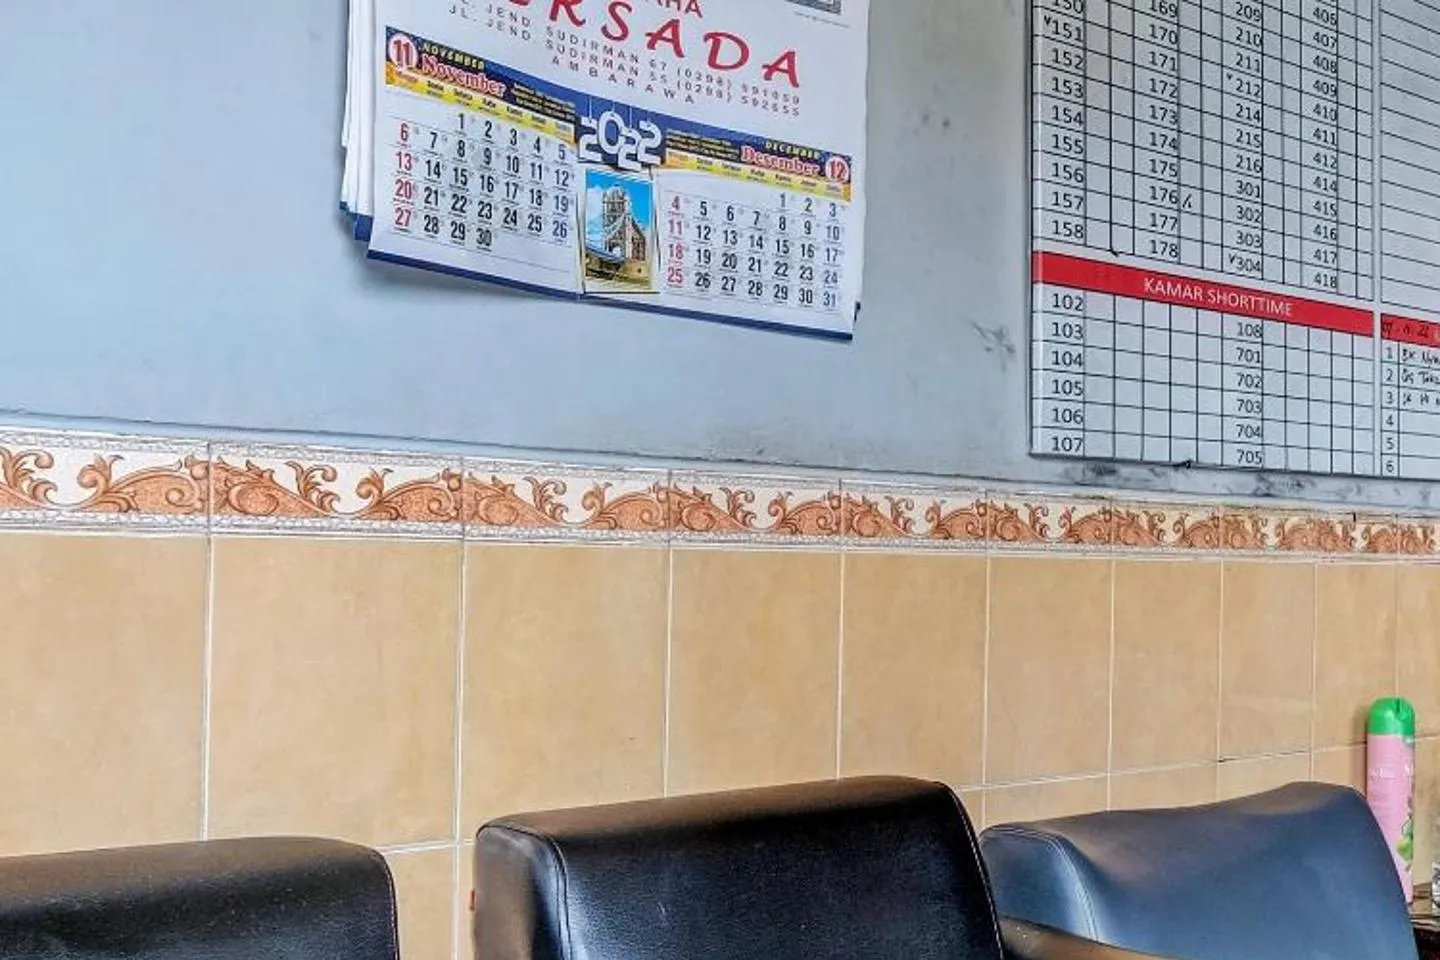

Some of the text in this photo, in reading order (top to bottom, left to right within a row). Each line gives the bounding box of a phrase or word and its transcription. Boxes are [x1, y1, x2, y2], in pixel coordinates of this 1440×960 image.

[1236, 2, 1261, 22] 209
[1052, 20, 1082, 41] 151
[1150, 24, 1178, 44] 170
[1236, 27, 1261, 46] 210
[509, 0, 800, 89] RSADA
[546, 26, 638, 63] SUDIRMAN
[1313, 32, 1336, 49] 407
[392, 38, 414, 69] 11
[423, 43, 485, 70] NOVEMBER
[546, 39, 638, 77] SUDIRMAN
[1052, 48, 1084, 69] 152
[1150, 52, 1177, 71] 171
[1236, 52, 1260, 72] 211
[1313, 56, 1337, 73] 408
[420, 54, 507, 98] November
[552, 56, 695, 104] AMBARAWA
[1052, 77, 1084, 98] 153
[1150, 79, 1178, 98] 172
[1236, 78, 1260, 97] 212
[1313, 80, 1337, 97] 409
[1052, 105, 1083, 126] 154
[1150, 105, 1178, 125] 173
[1236, 103, 1260, 122] 214
[1313, 104, 1337, 121] 410
[460, 113, 565, 159] 1 2 3 4 5
[577, 110, 663, 171] 2022
[1052, 134, 1084, 154] 155
[1150, 132, 1178, 150] 174
[1236, 129, 1261, 148] 215
[1313, 128, 1335, 145] 411
[400, 123, 569, 187] 6 7 8 9 10 11 12
[741, 145, 821, 176] Desember
[1236, 154, 1261, 173] 216
[1313, 153, 1337, 169] 412
[830, 158, 847, 182] 12
[1052, 163, 1084, 183] 156
[1150, 159, 1178, 177] 175
[397, 152, 568, 212] 13 14 15 16 17 18 19
[1236, 180, 1260, 198] 301
[1313, 177, 1337, 192] 414
[1052, 192, 1084, 211] 157
[1150, 186, 1178, 204] 176
[395, 180, 567, 238] 20 21 22 23 24 25 26
[780, 194, 836, 217] 1 2 3
[1236, 205, 1261, 223] 302
[1313, 201, 1337, 217] 415
[395, 208, 492, 246] 27 28 29 30
[672, 196, 839, 240] 4 5 6 7 8 9 10
[1150, 213, 1178, 231] 177
[1052, 220, 1084, 239] 158
[1313, 224, 1337, 240] 416
[670, 219, 838, 262] 11 12 13 14 15 16 17
[1150, 240, 1178, 258] 178
[1236, 231, 1261, 248] 303
[669, 244, 837, 284] 18 19 20 21 22 23 24
[1237, 257, 1260, 271] 304
[1313, 249, 1337, 263] 417
[667, 267, 836, 307] 25 26 27 28 29 30 31
[1313, 273, 1337, 288] 418
[1051, 293, 1083, 311] 102
[1144, 278, 1292, 316] KAMAR SHORTTIME
[1051, 322, 1083, 339] 103
[1236, 322, 1262, 338] 108
[1051, 351, 1083, 367] 104
[1236, 348, 1261, 363] 701
[1386, 347, 1392, 359] 1
[1236, 373, 1262, 389] 702
[1386, 371, 1393, 382] 2
[1051, 380, 1083, 396] 105
[1236, 400, 1262, 414] 703
[1386, 392, 1393, 404] 3
[1051, 408, 1083, 424] 106
[1386, 415, 1393, 426] 4
[1236, 425, 1261, 439] 704
[1051, 437, 1083, 453] 107
[1386, 437, 1393, 449] 5
[1236, 450, 1262, 464] 705
[1386, 460, 1394, 472] 6
